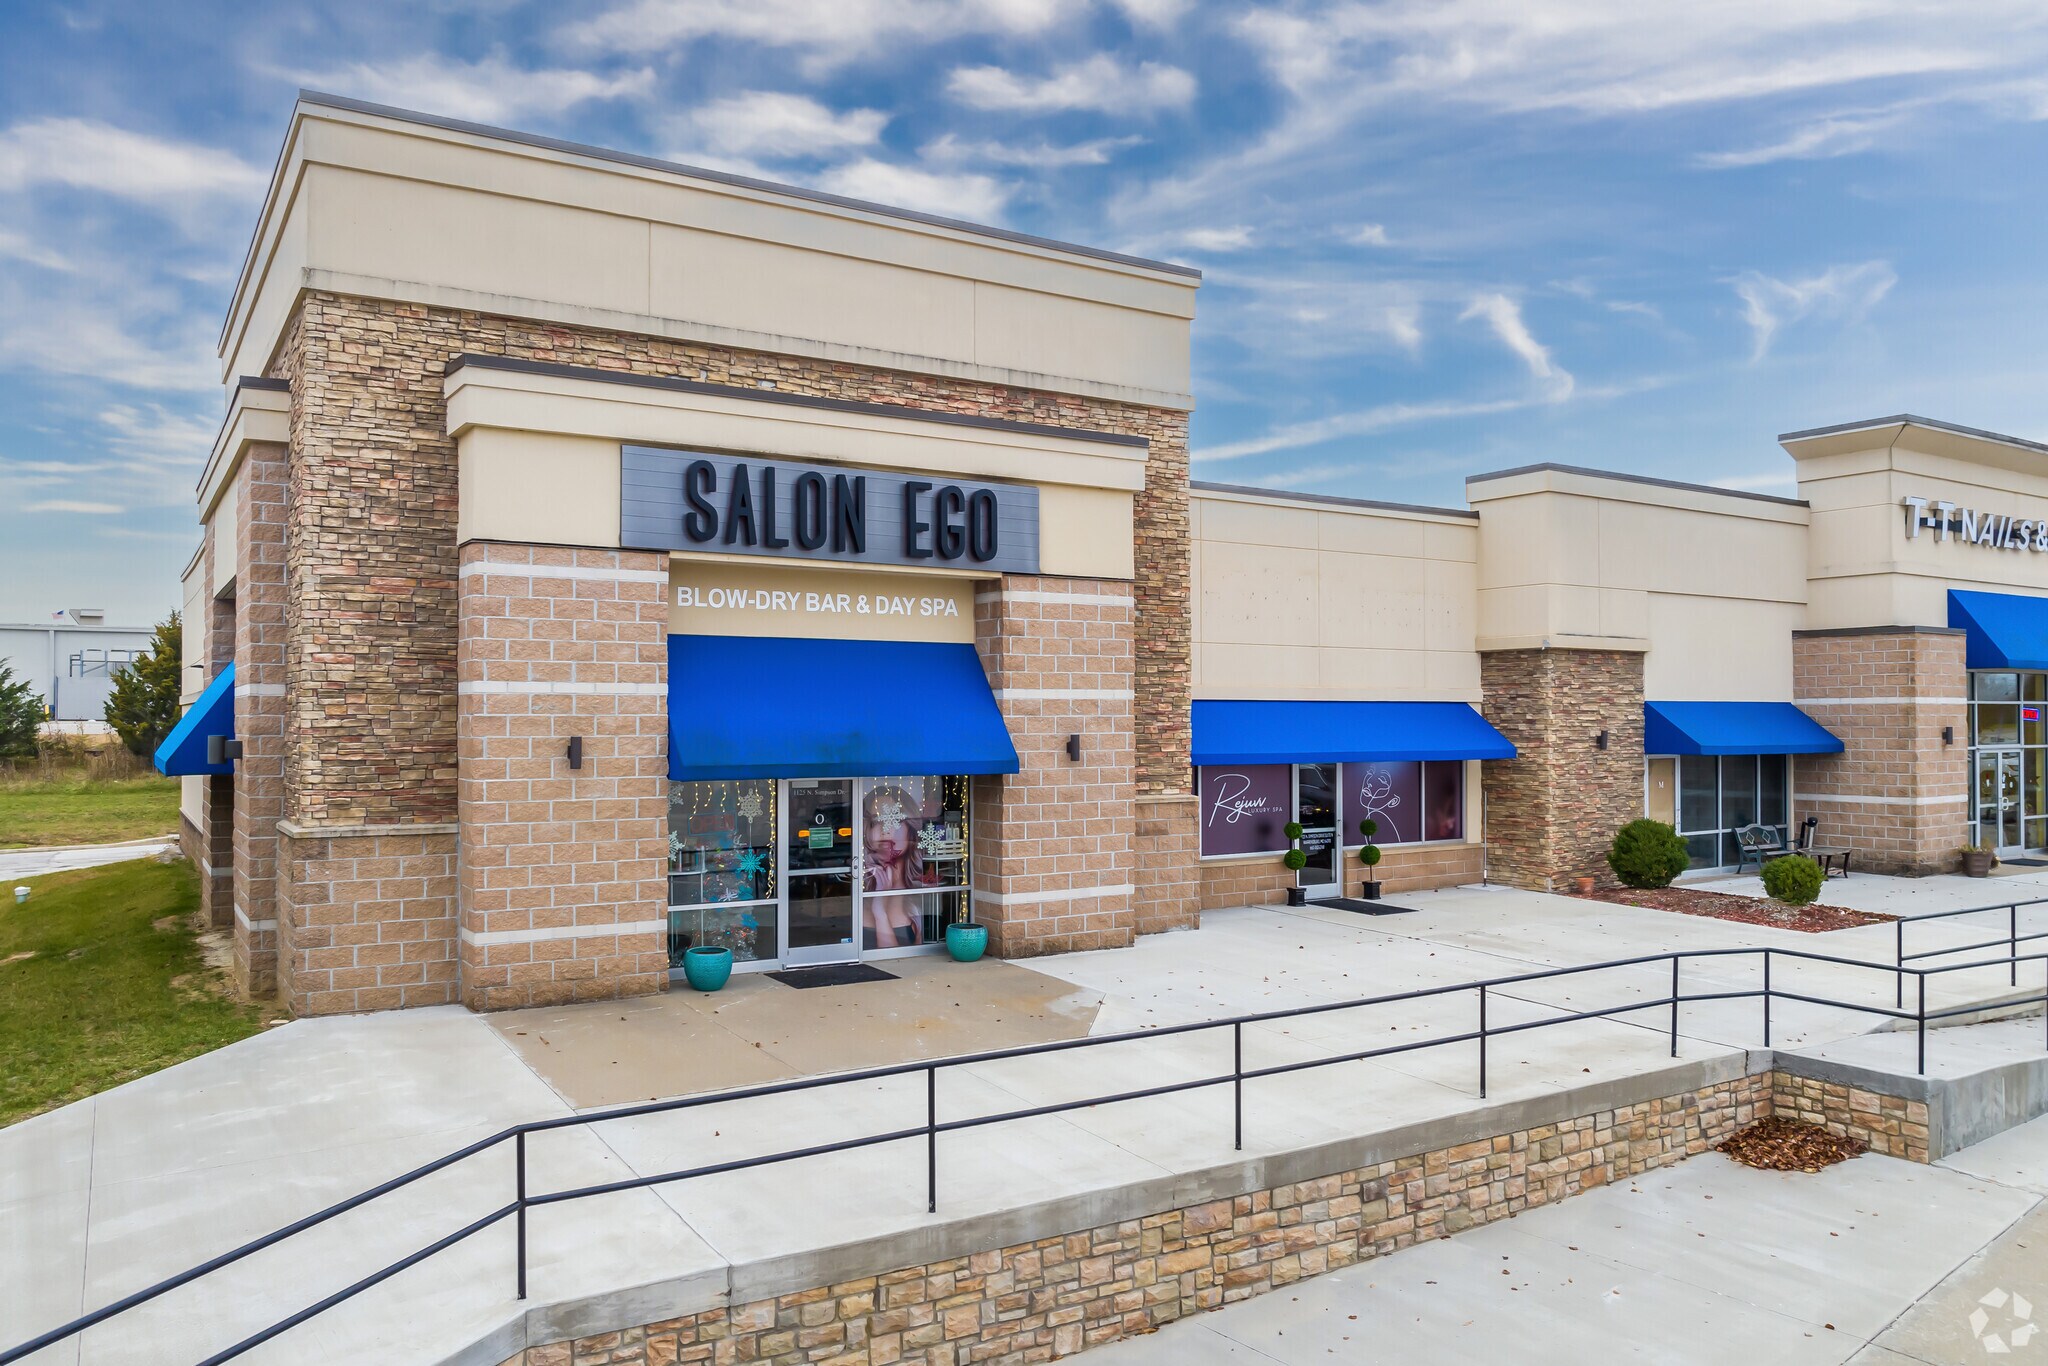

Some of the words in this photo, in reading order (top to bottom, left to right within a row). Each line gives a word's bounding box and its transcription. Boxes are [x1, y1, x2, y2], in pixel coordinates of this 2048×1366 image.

[685, 459, 866, 554] SALON
[905, 480, 998, 562] EGO
[1958, 507, 2033, 552] NAILS
[676, 586, 801, 611] BLOW-DRY
[805, 591, 851, 614] BAR
[856, 595, 871, 614] &
[875, 596, 916, 616] DAY
[919, 597, 959, 617] SPA
